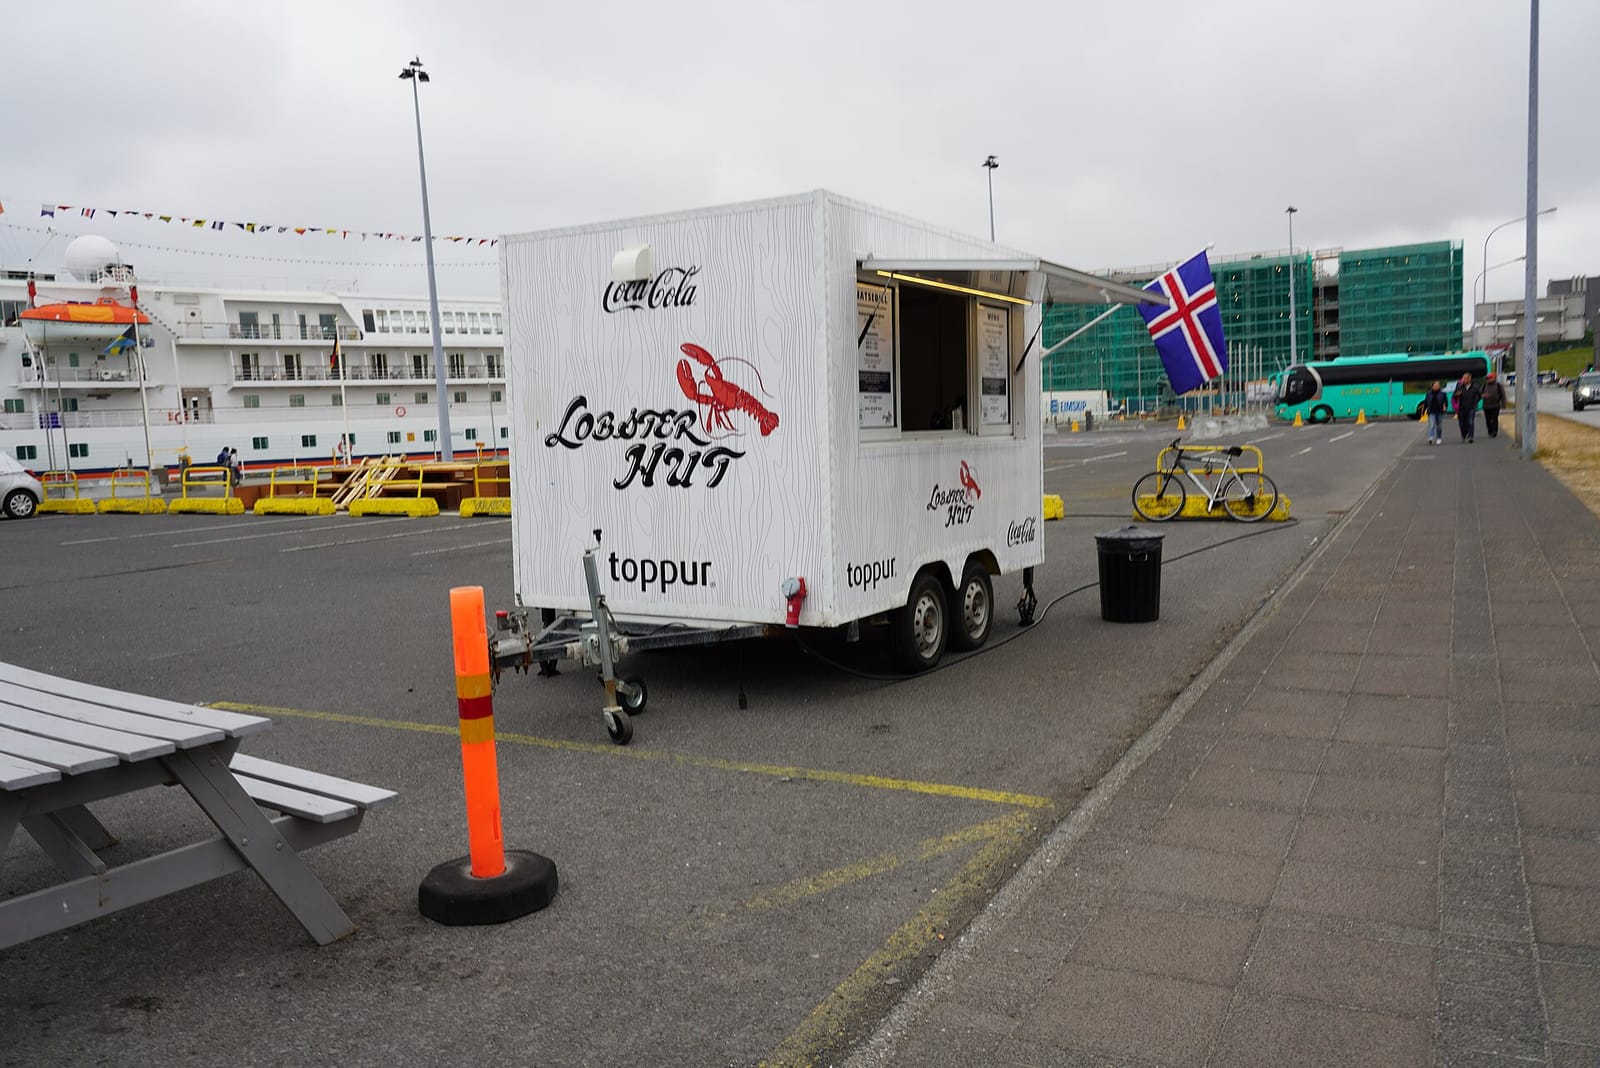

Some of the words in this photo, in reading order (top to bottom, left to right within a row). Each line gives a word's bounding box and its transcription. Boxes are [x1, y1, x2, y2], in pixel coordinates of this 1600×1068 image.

[1060, 399, 1087, 413] EIMSKIP
[613, 442, 746, 490] HUT
[944, 503, 975, 528] HUT
[608, 552, 712, 593] toppur
[846, 557, 896, 592] toppur
